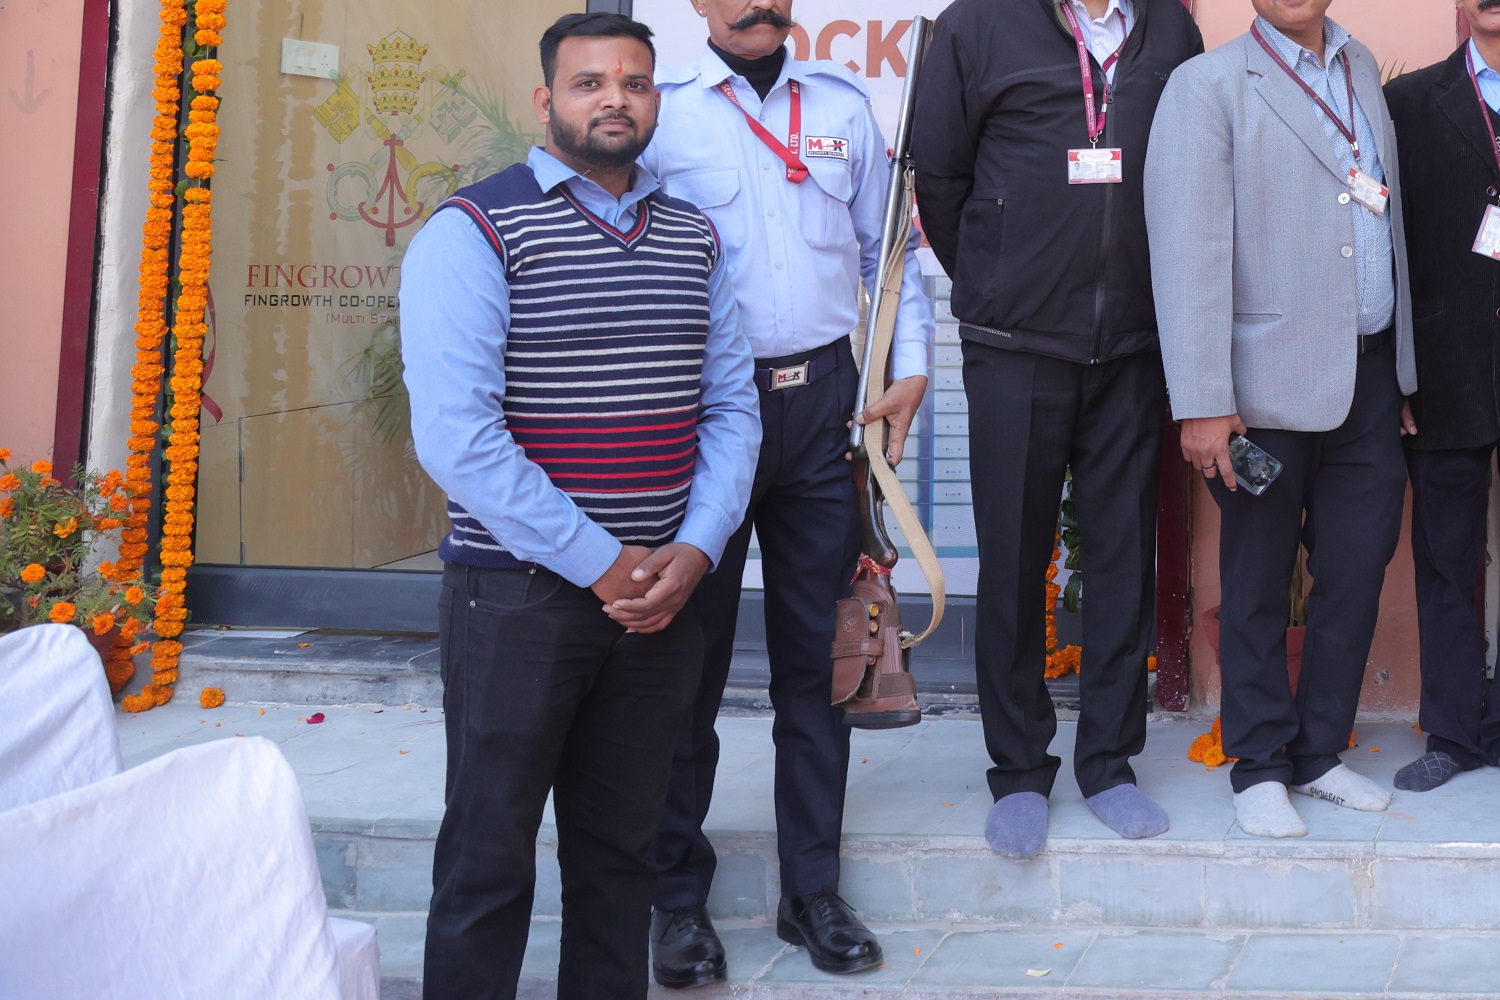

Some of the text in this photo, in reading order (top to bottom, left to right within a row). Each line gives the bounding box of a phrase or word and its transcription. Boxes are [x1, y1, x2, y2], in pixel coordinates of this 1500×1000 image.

[790, 132, 800, 147] LTD.
[808, 138, 843, 152] MAX
[244, 294, 333, 307] FINGROWTH
